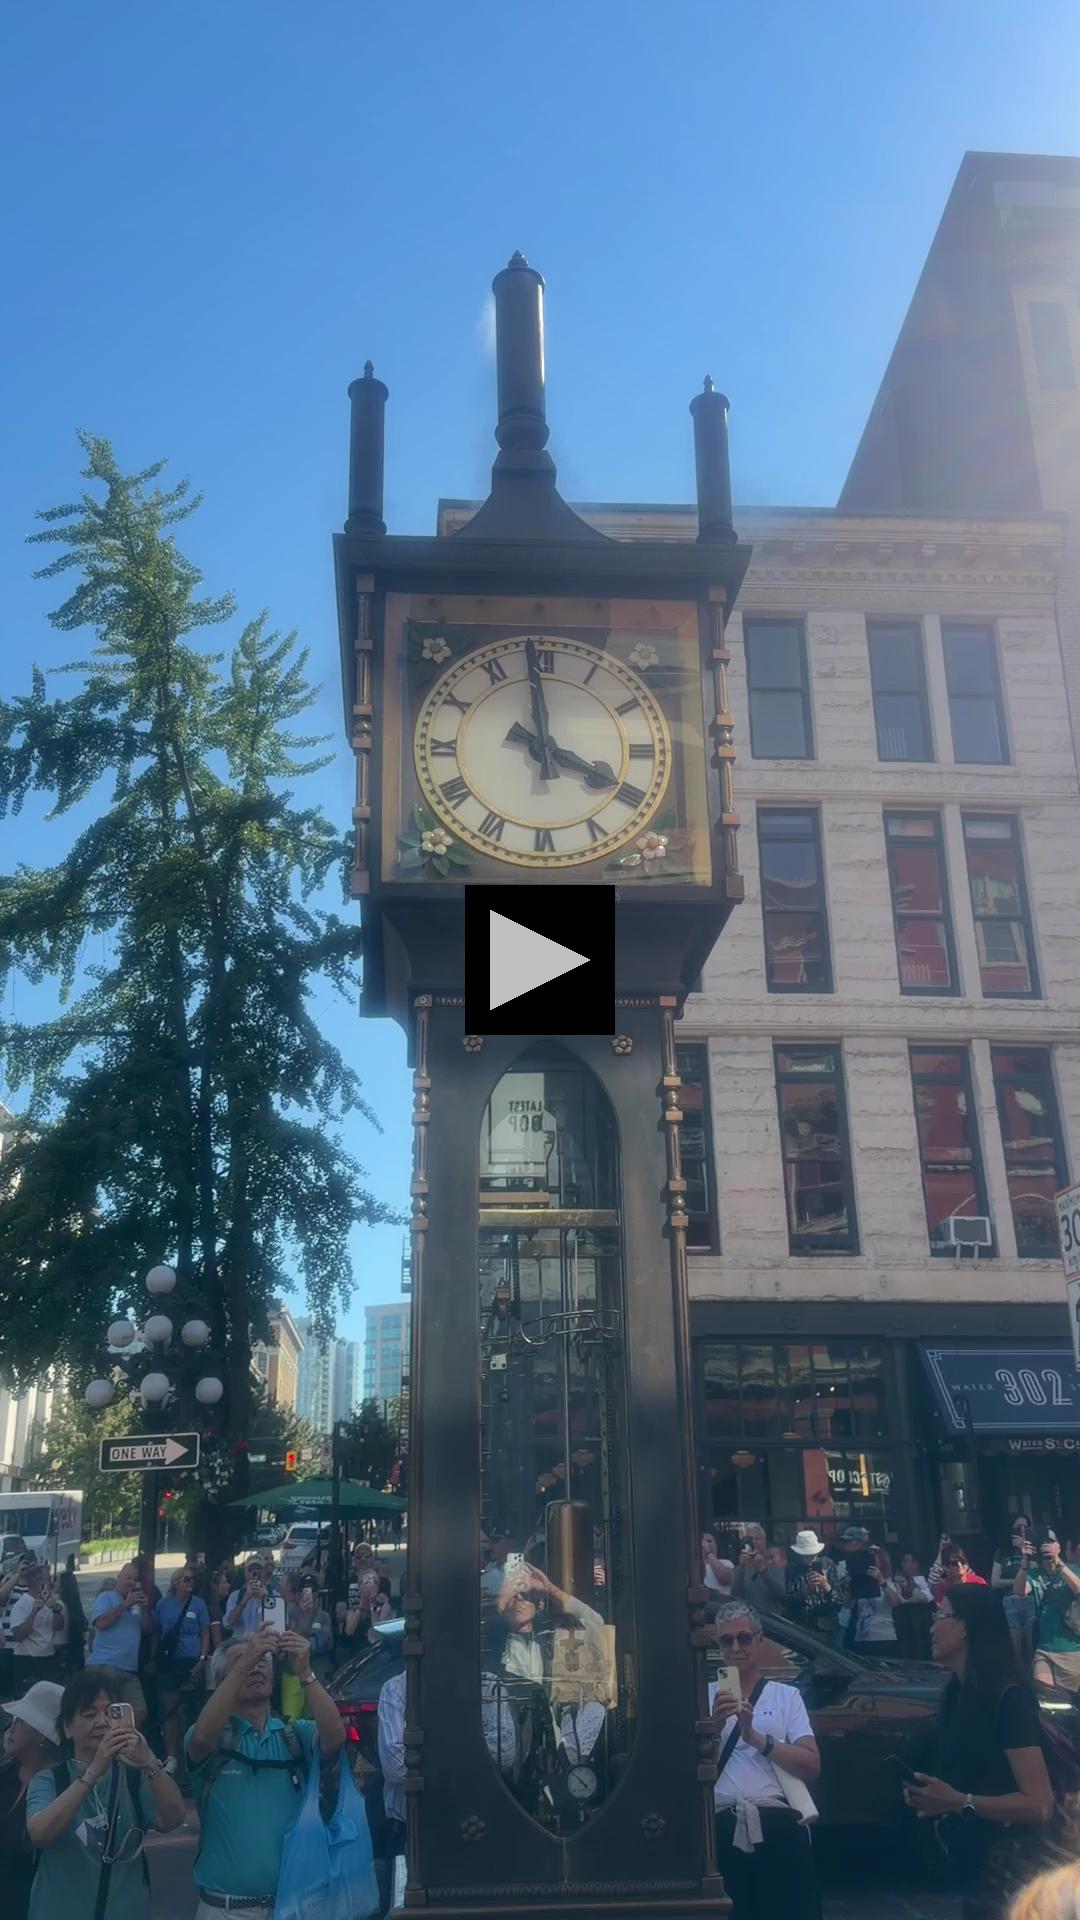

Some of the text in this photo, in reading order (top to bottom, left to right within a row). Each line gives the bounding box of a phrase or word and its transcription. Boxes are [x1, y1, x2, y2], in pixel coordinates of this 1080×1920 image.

[995, 1369, 1073, 1405] 302
[111, 1446, 168, 1460] ONE WAY
